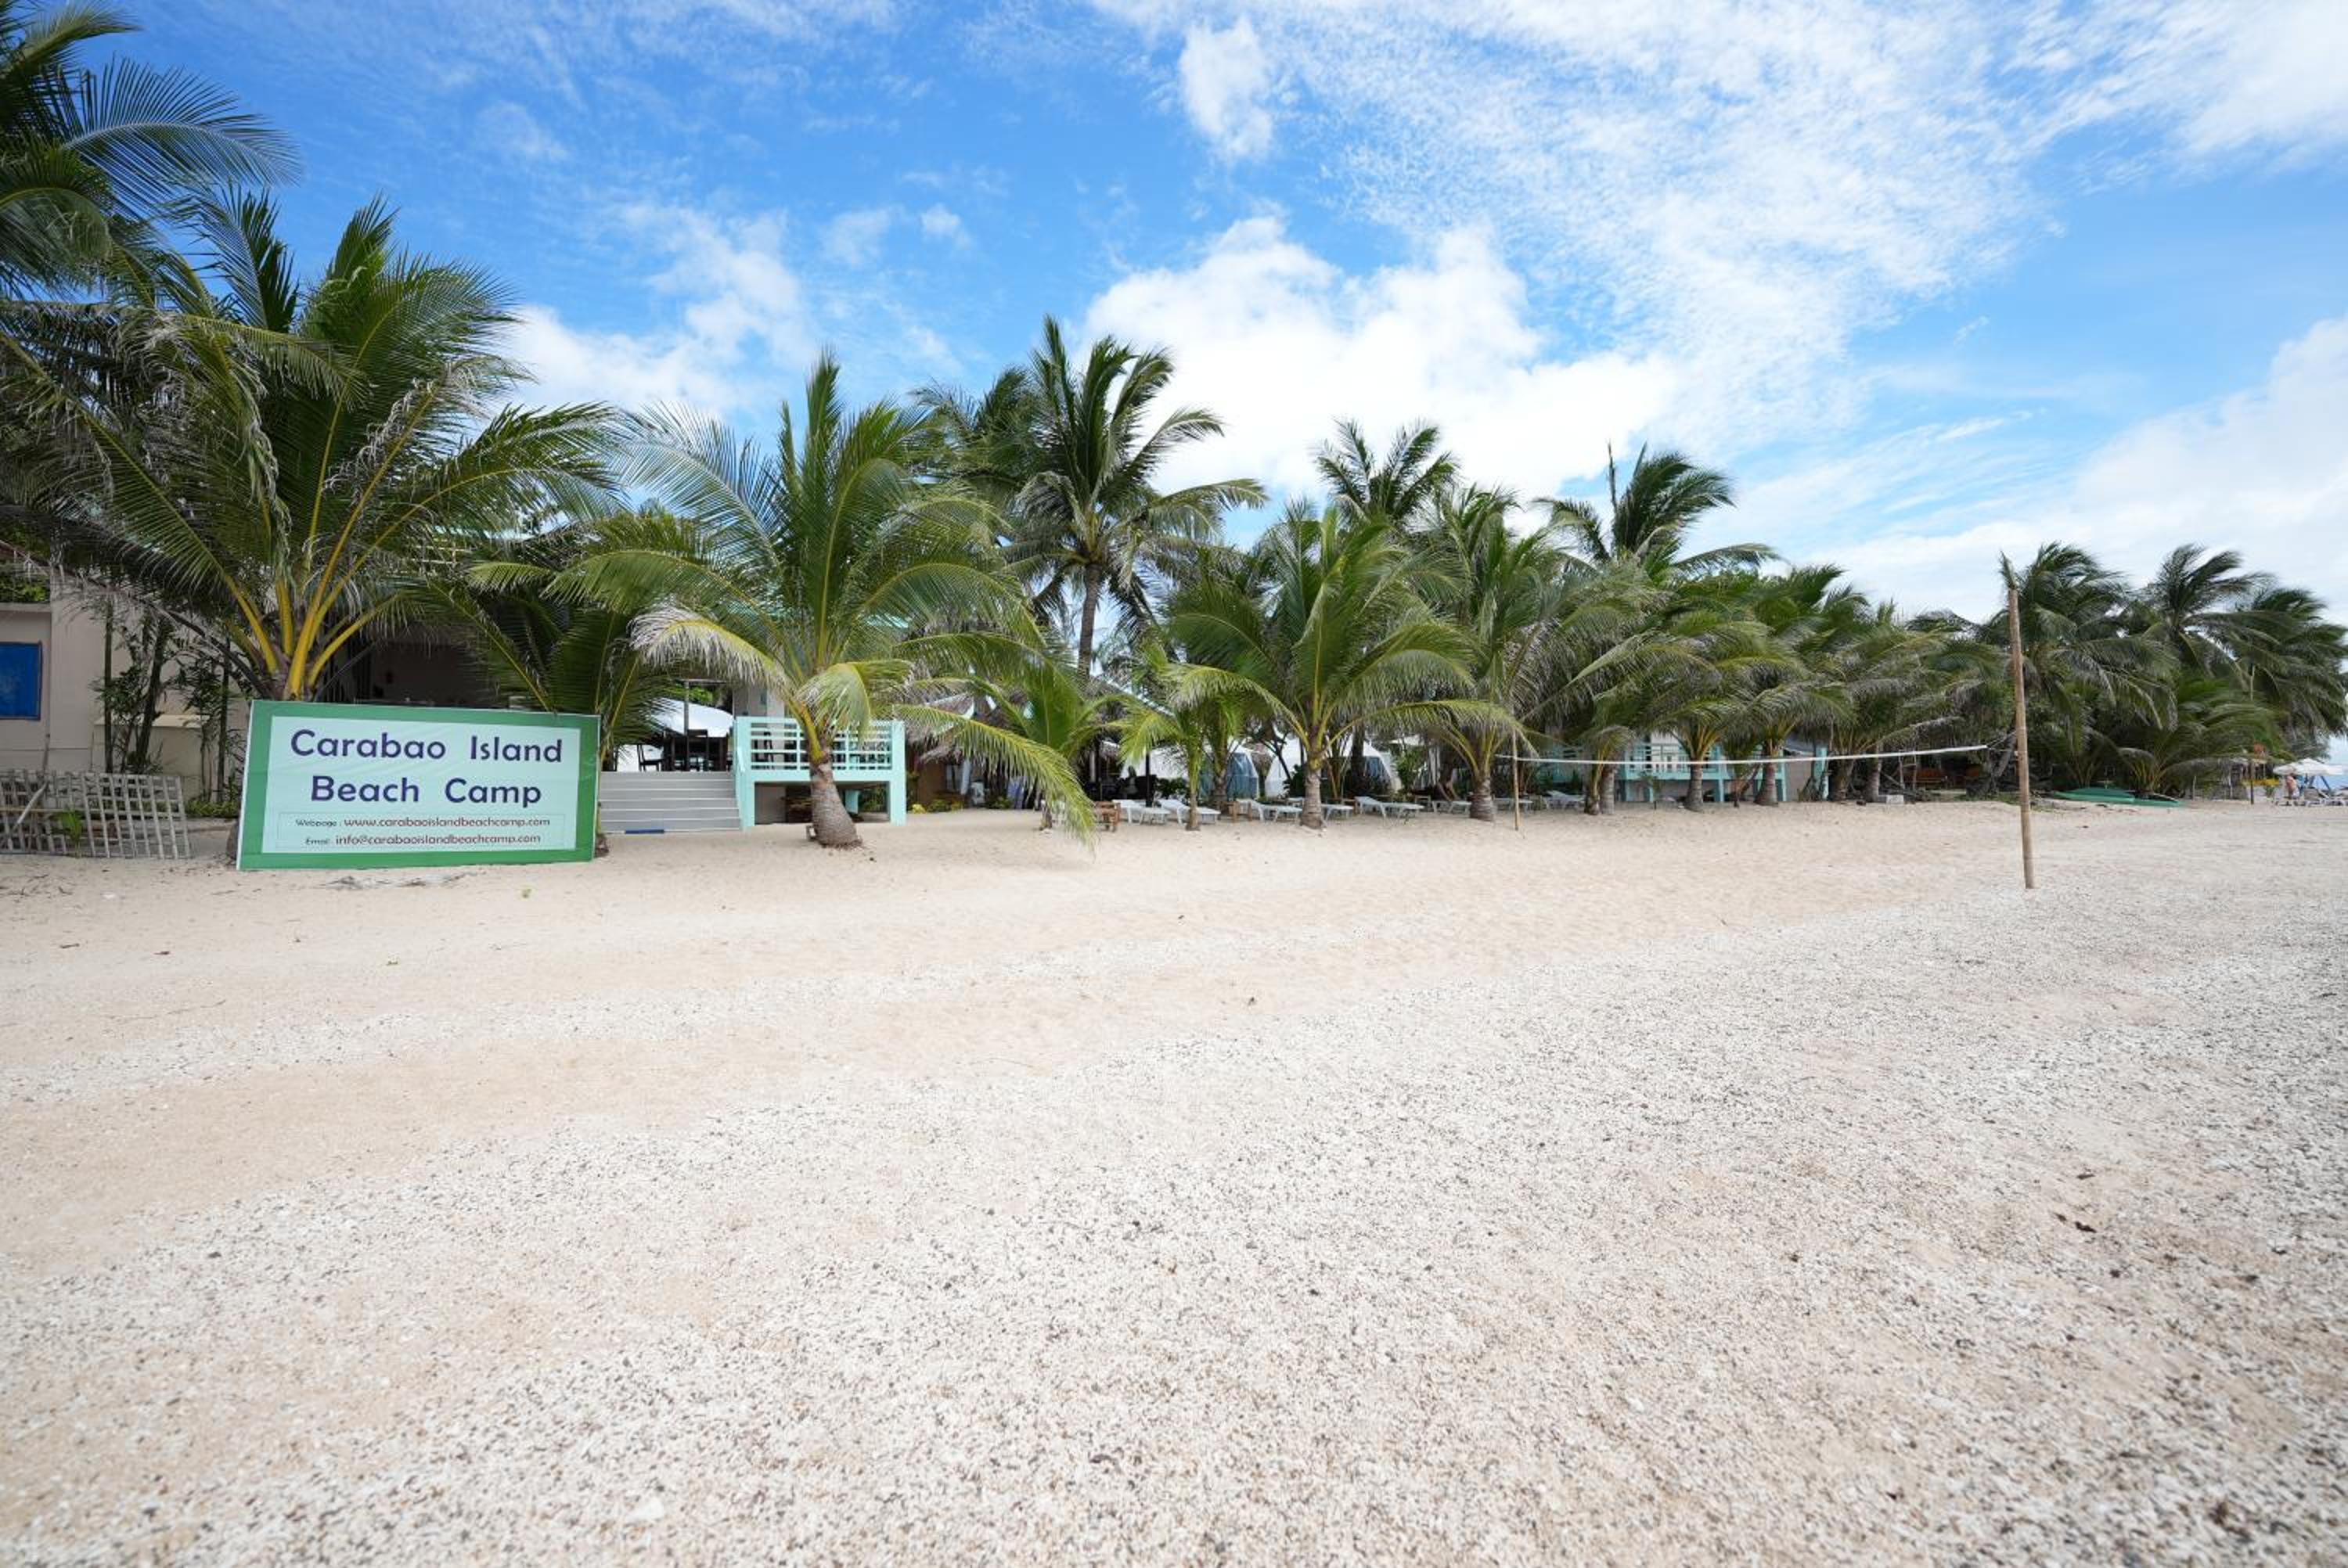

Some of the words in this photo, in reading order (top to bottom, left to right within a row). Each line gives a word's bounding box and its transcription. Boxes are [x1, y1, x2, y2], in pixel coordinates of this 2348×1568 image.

[290, 728, 446, 760] Carabao
[470, 735, 563, 763] Island
[311, 775, 420, 802] Beach
[445, 777, 542, 808] Camp
[344, 817, 551, 828] www.carabaoislandbeachcamp.com
[335, 834, 542, 846] info@carabaoislandbeachcamp.com
